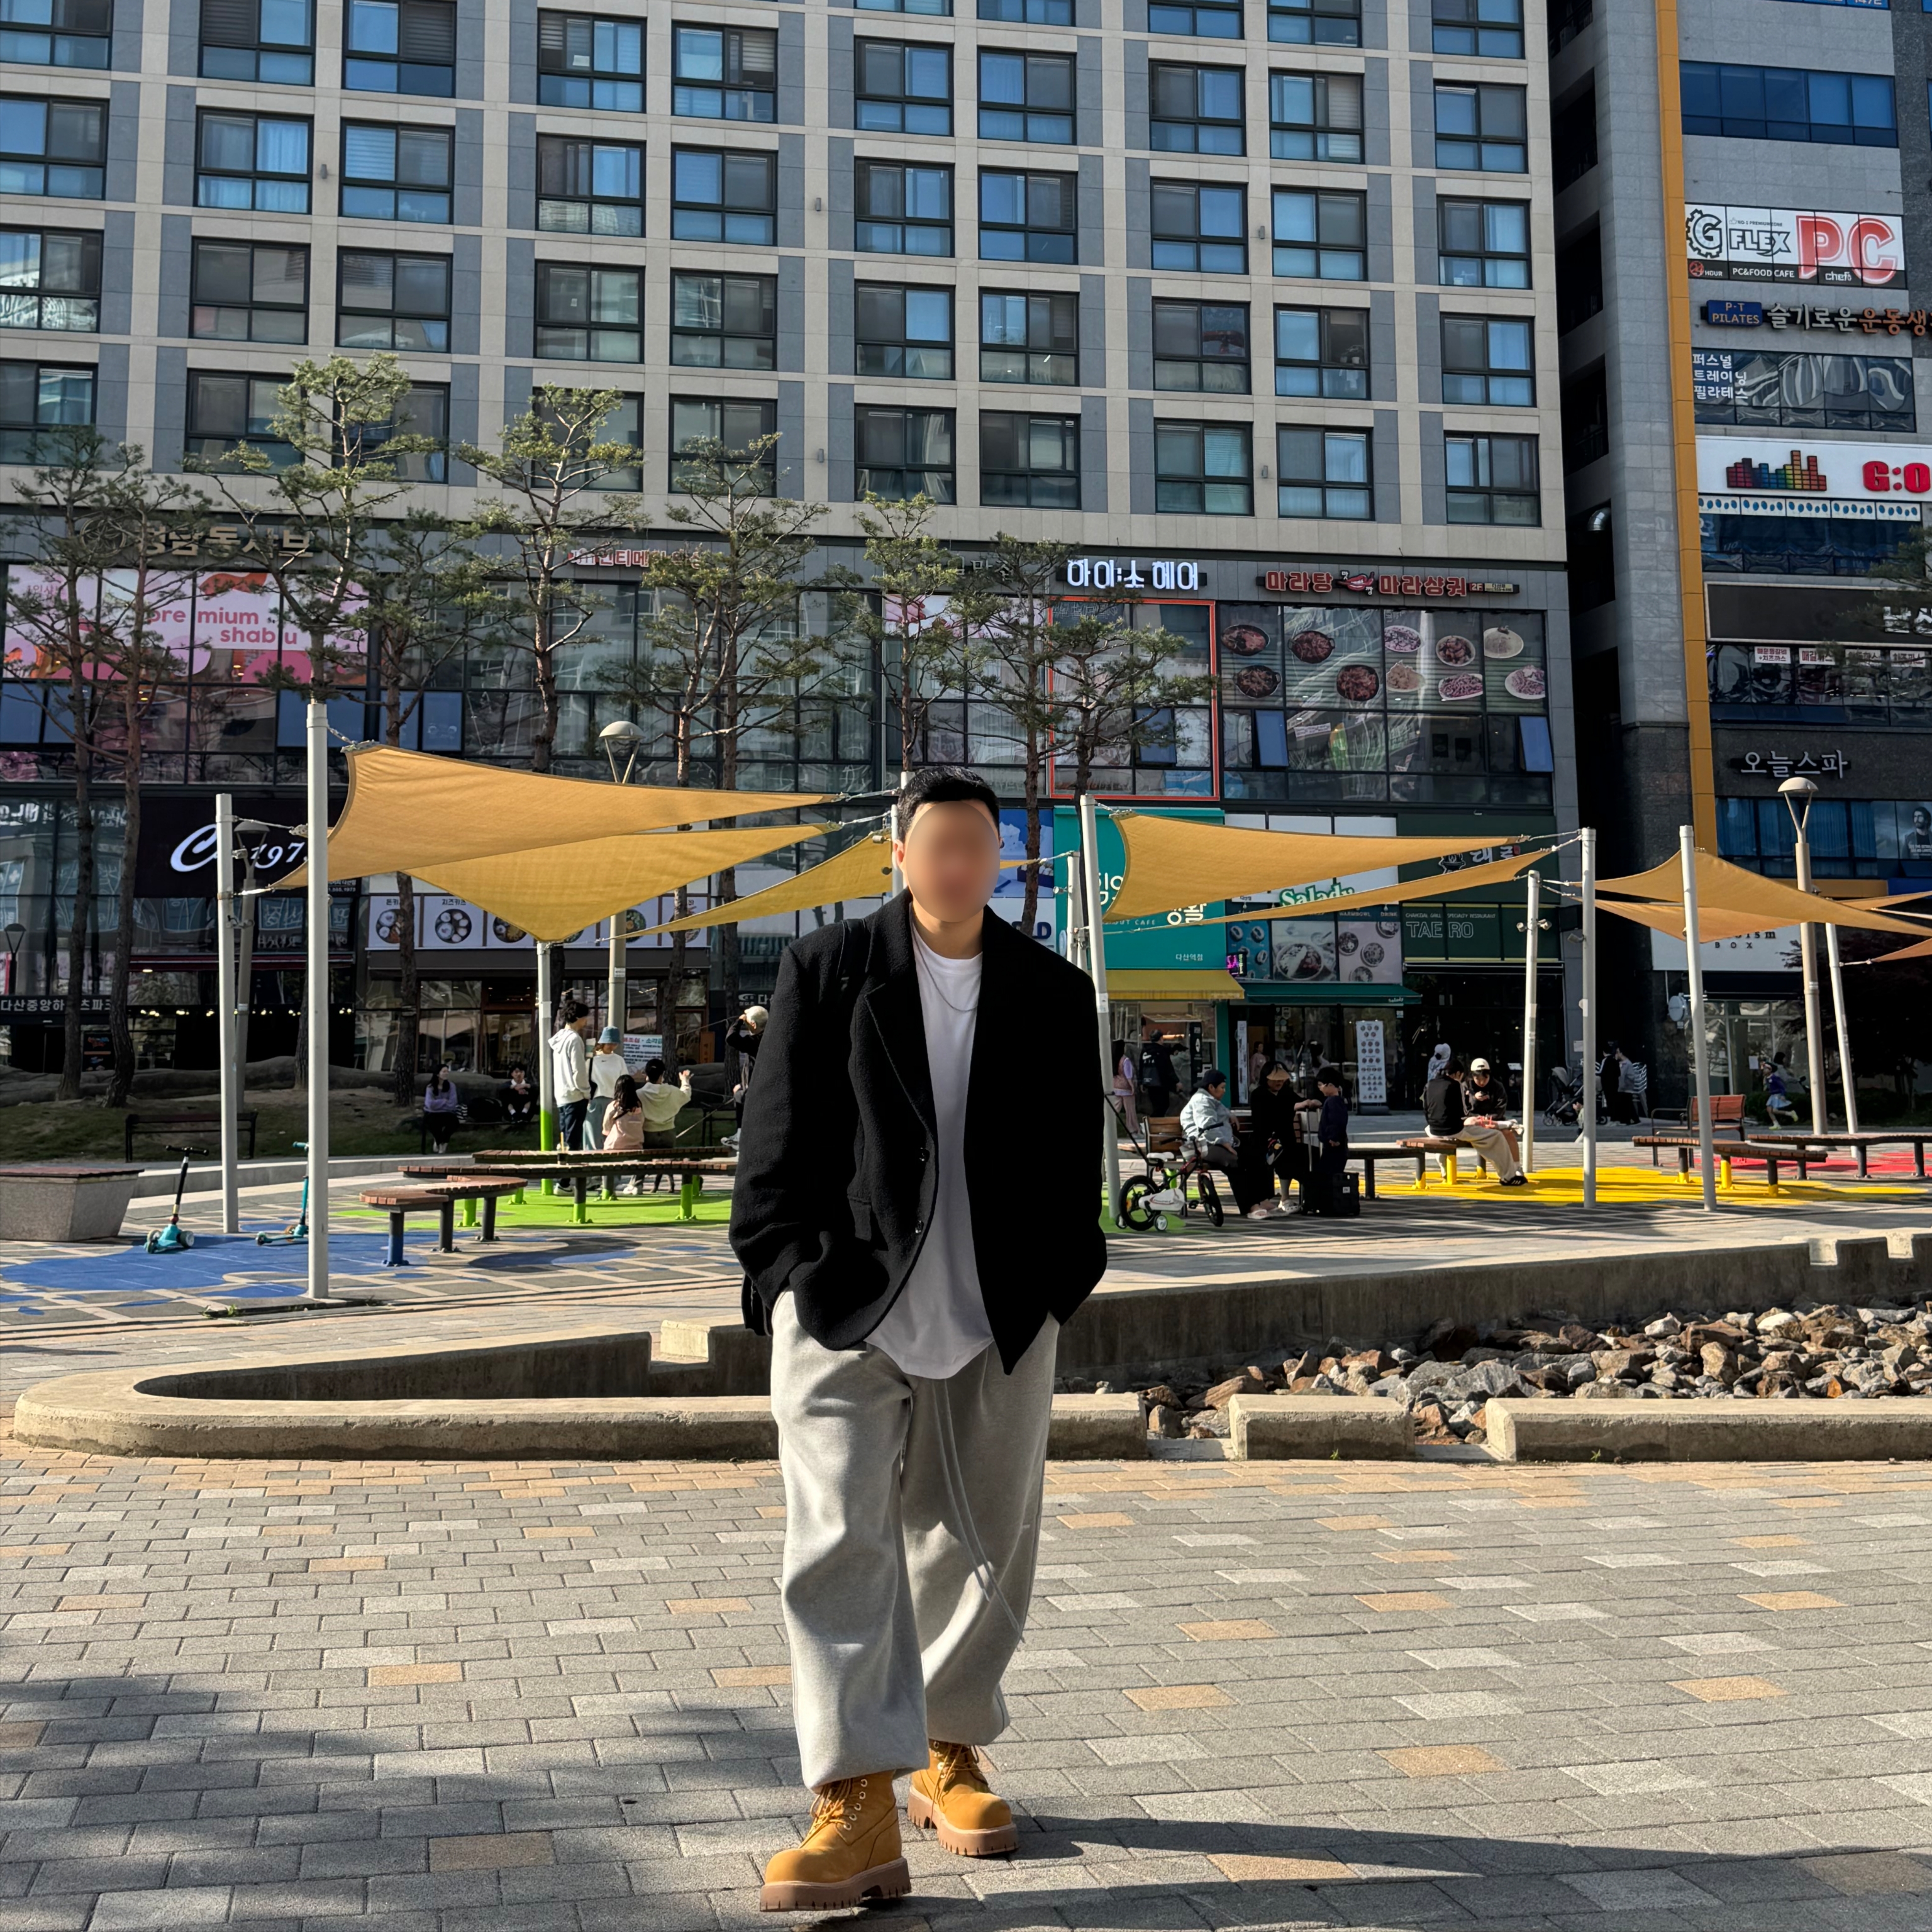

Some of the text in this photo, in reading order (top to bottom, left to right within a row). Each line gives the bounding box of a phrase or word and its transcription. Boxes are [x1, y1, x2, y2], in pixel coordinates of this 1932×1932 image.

[1729, 228, 1791, 257] FLEX
[1796, 216, 1898, 285] PC
[1733, 267, 1794, 277] PC&FOOD CAFE
[1712, 313, 1760, 324] PILATES
[1767, 303, 1932, 336] 슬기로운 운동생
[1692, 353, 1732, 369] 퍼스널
[1693, 370, 1747, 386] 트레이닝
[1694, 385, 1748, 400] 필라테스
[1152, 561, 1199, 591] 헤어
[1265, 570, 1333, 593] 마라탕
[1379, 575, 1467, 597] 마라샹궈
[1471, 583, 1483, 591] 2F
[1741, 750, 1848, 779] 오늘스파
[250, 841, 308, 869] 197
[1406, 921, 1474, 938] TAE RO
[0, 999, 113, 1013] 다산중앙하츠파
